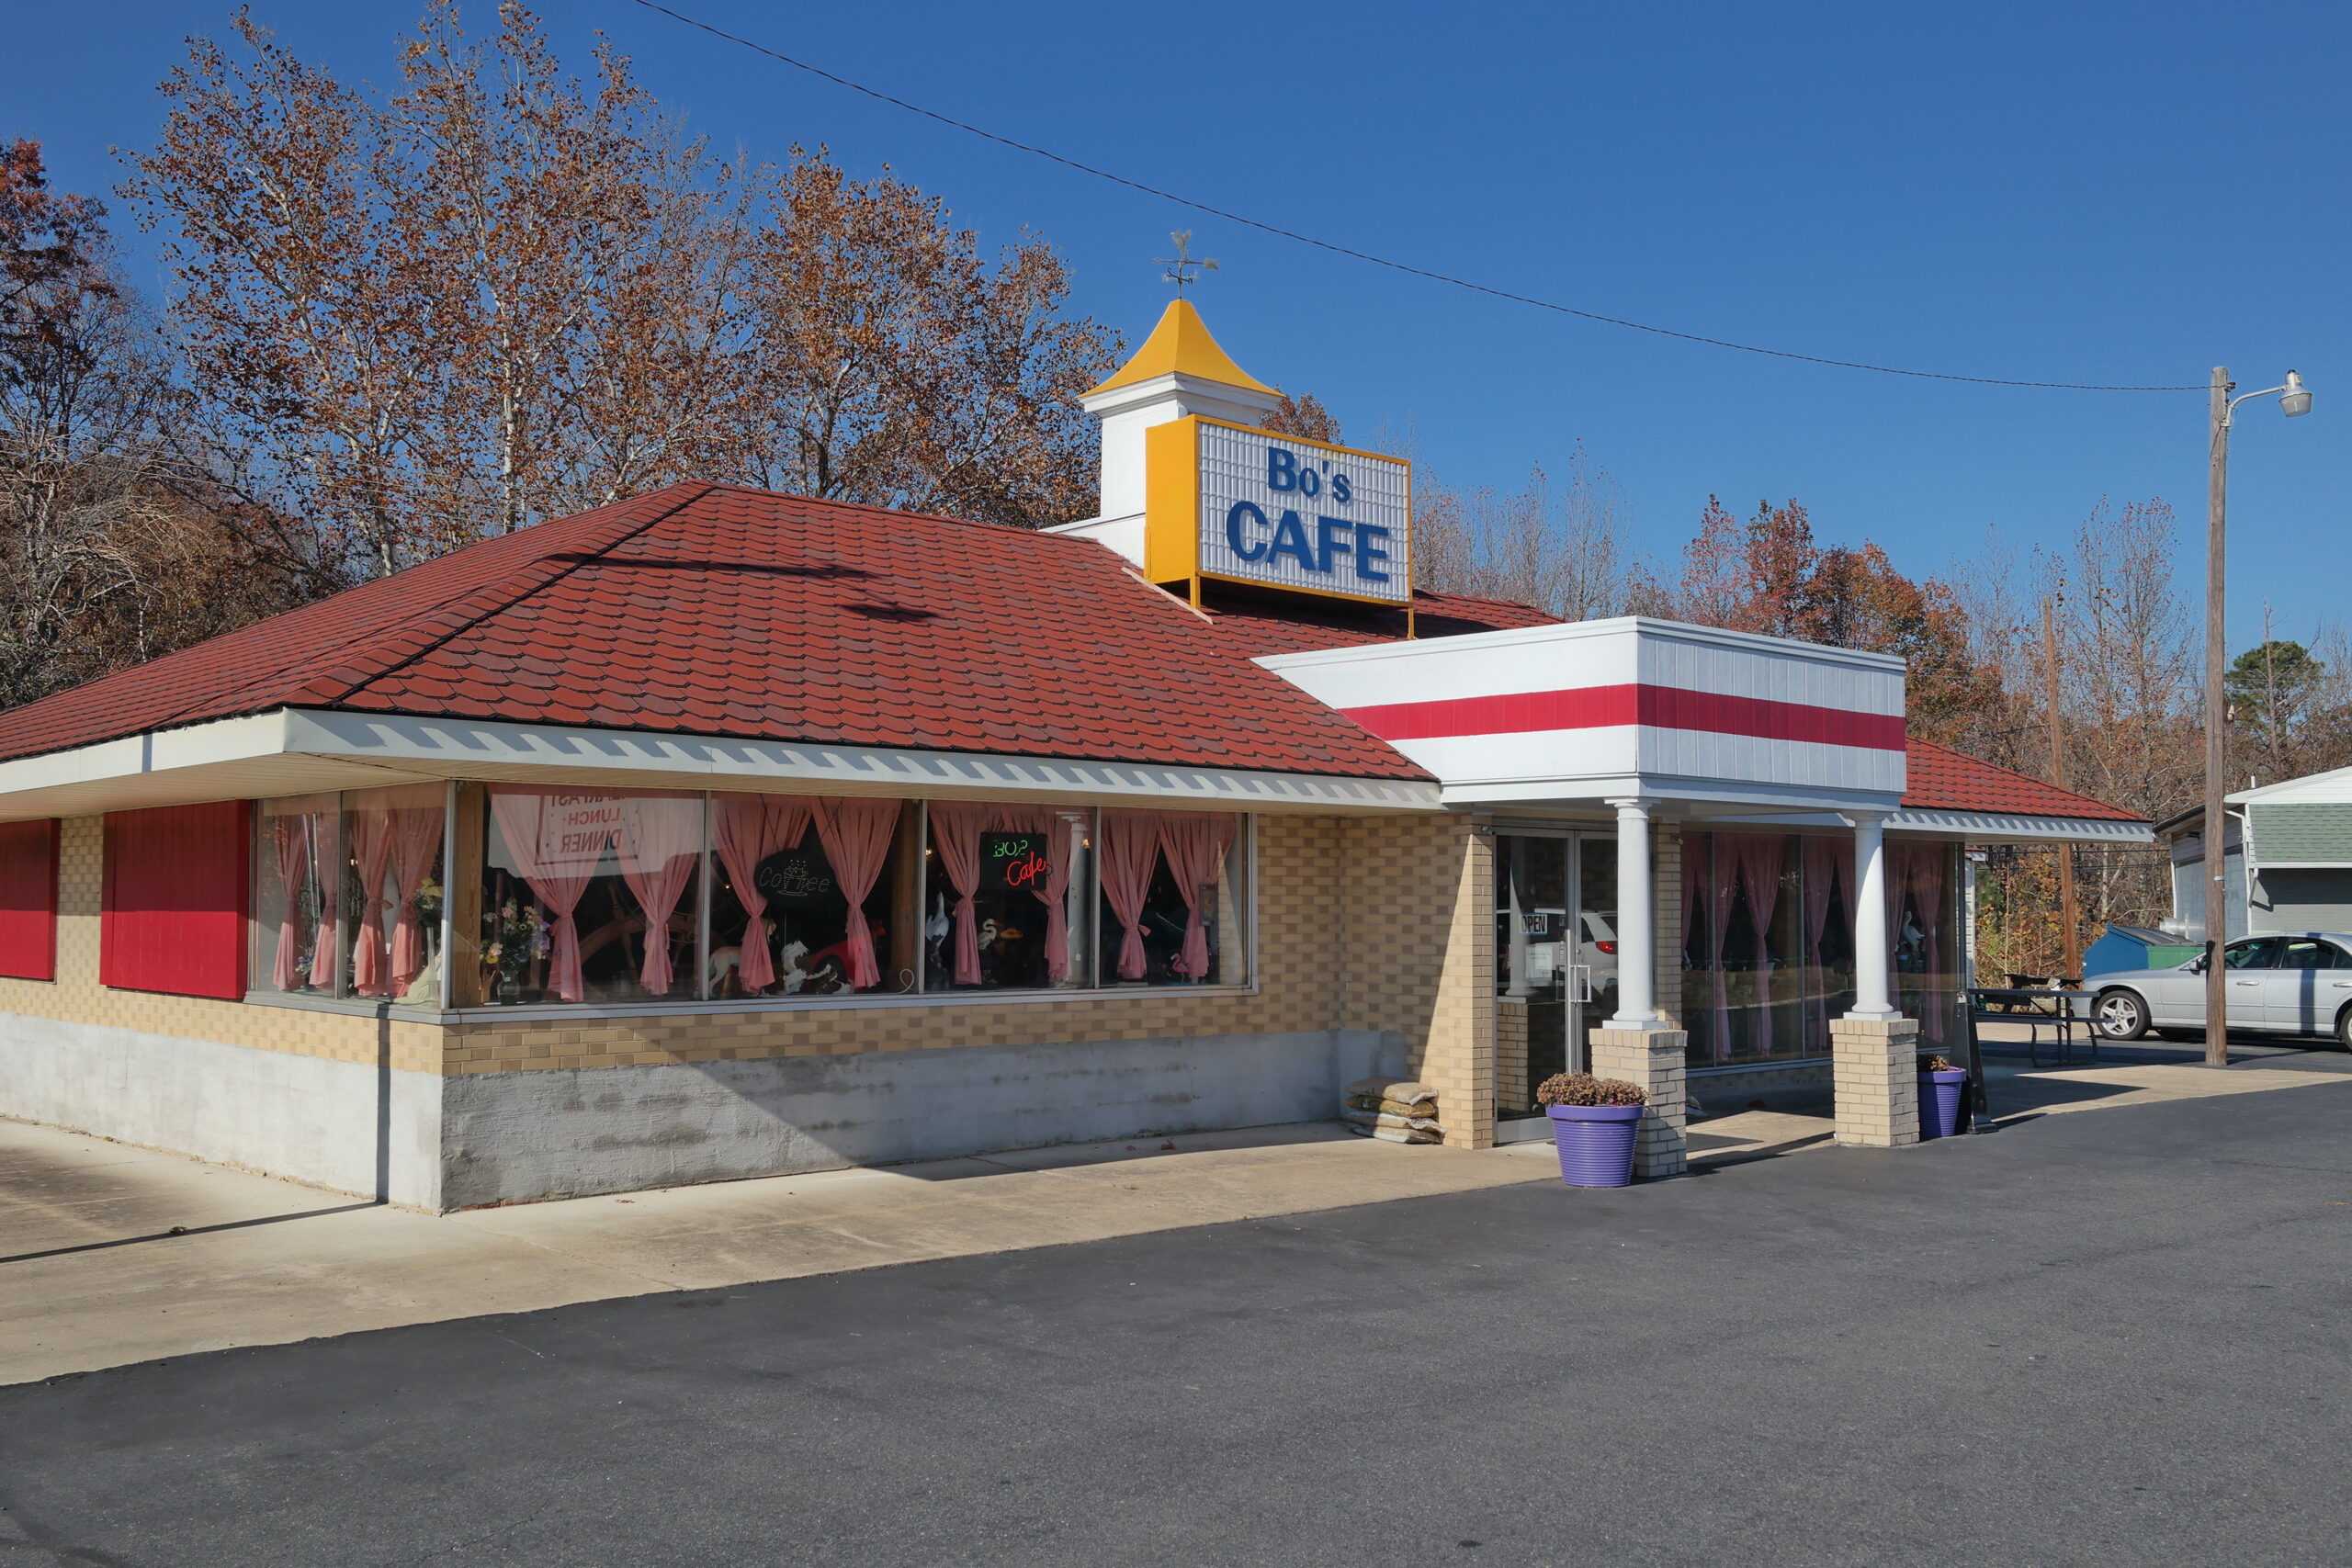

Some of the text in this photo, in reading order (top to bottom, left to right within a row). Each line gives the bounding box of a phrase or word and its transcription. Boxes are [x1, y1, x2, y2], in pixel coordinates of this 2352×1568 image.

[1268, 446, 1351, 502] Bo's
[1226, 501, 1389, 582] CAFE
[1007, 851, 1046, 886] Cafe
[1521, 915, 1546, 933] OPEN
